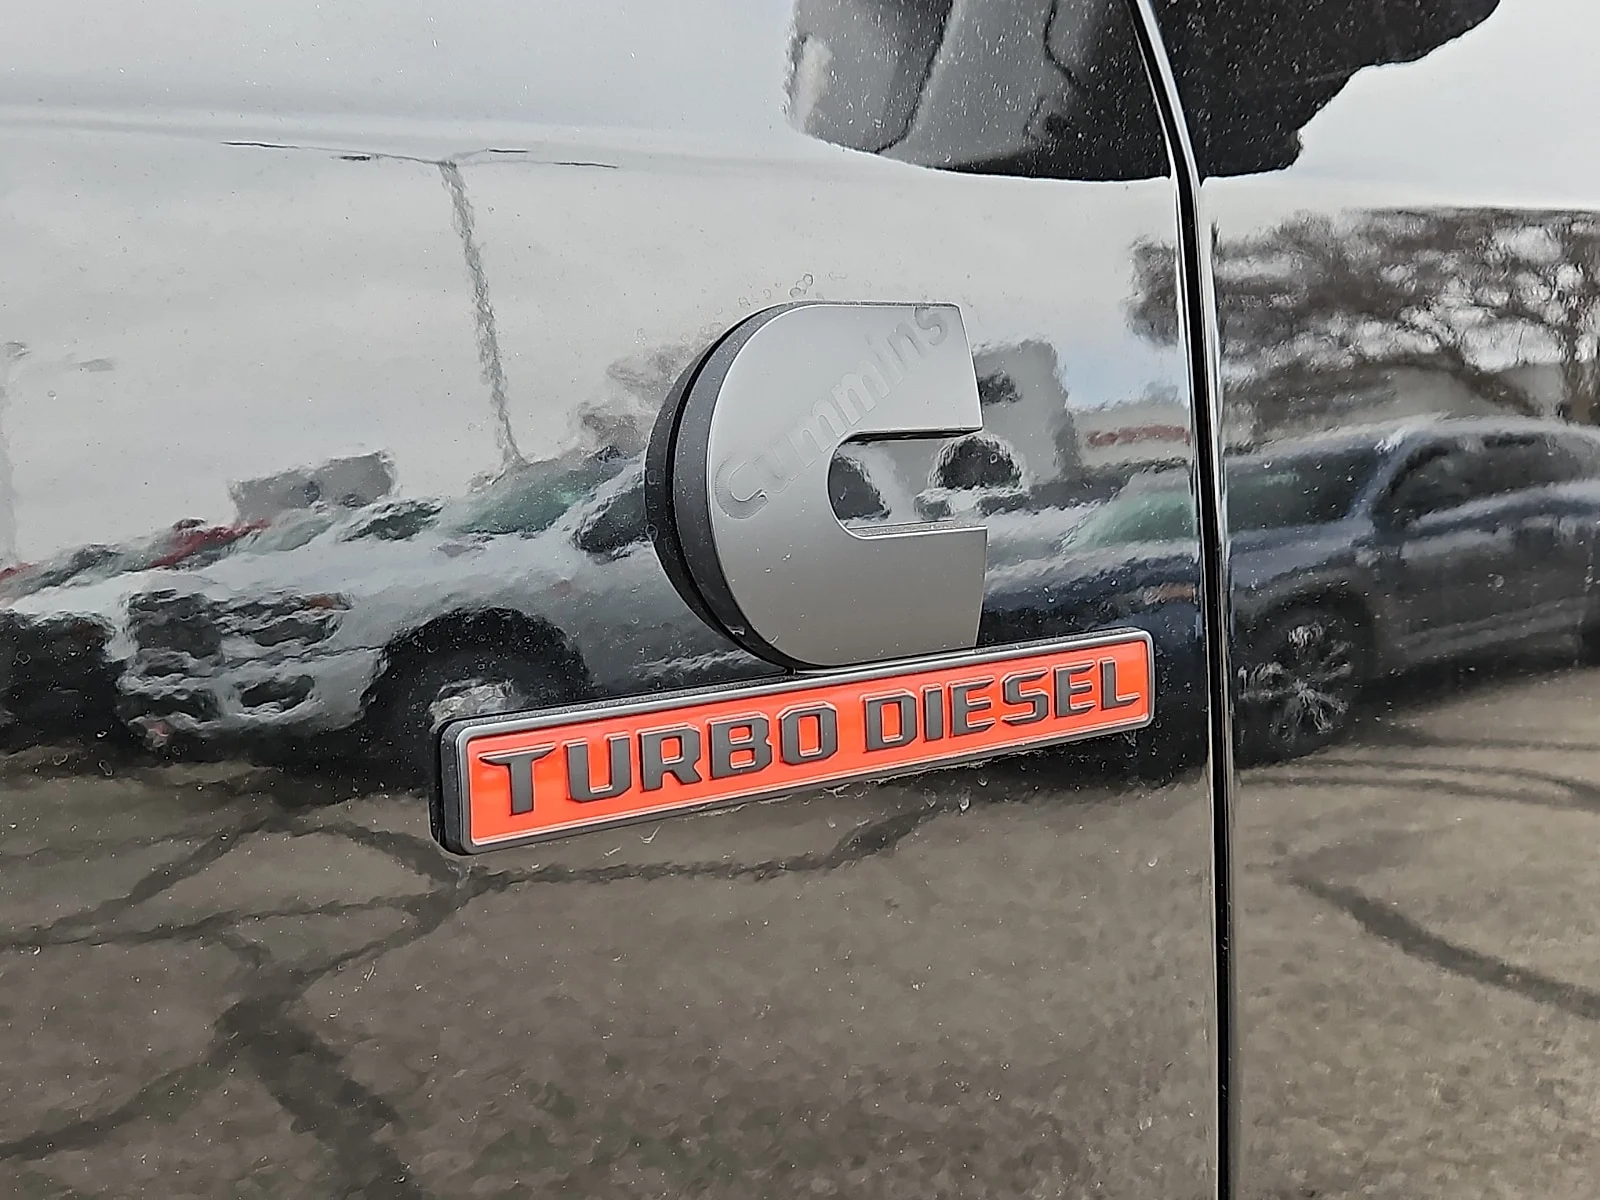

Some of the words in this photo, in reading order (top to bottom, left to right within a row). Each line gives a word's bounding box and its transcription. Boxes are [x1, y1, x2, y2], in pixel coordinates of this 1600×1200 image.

[714, 305, 949, 520] Cummins
[478, 701, 839, 817] TURBO
[861, 657, 1141, 753] DIESEL
